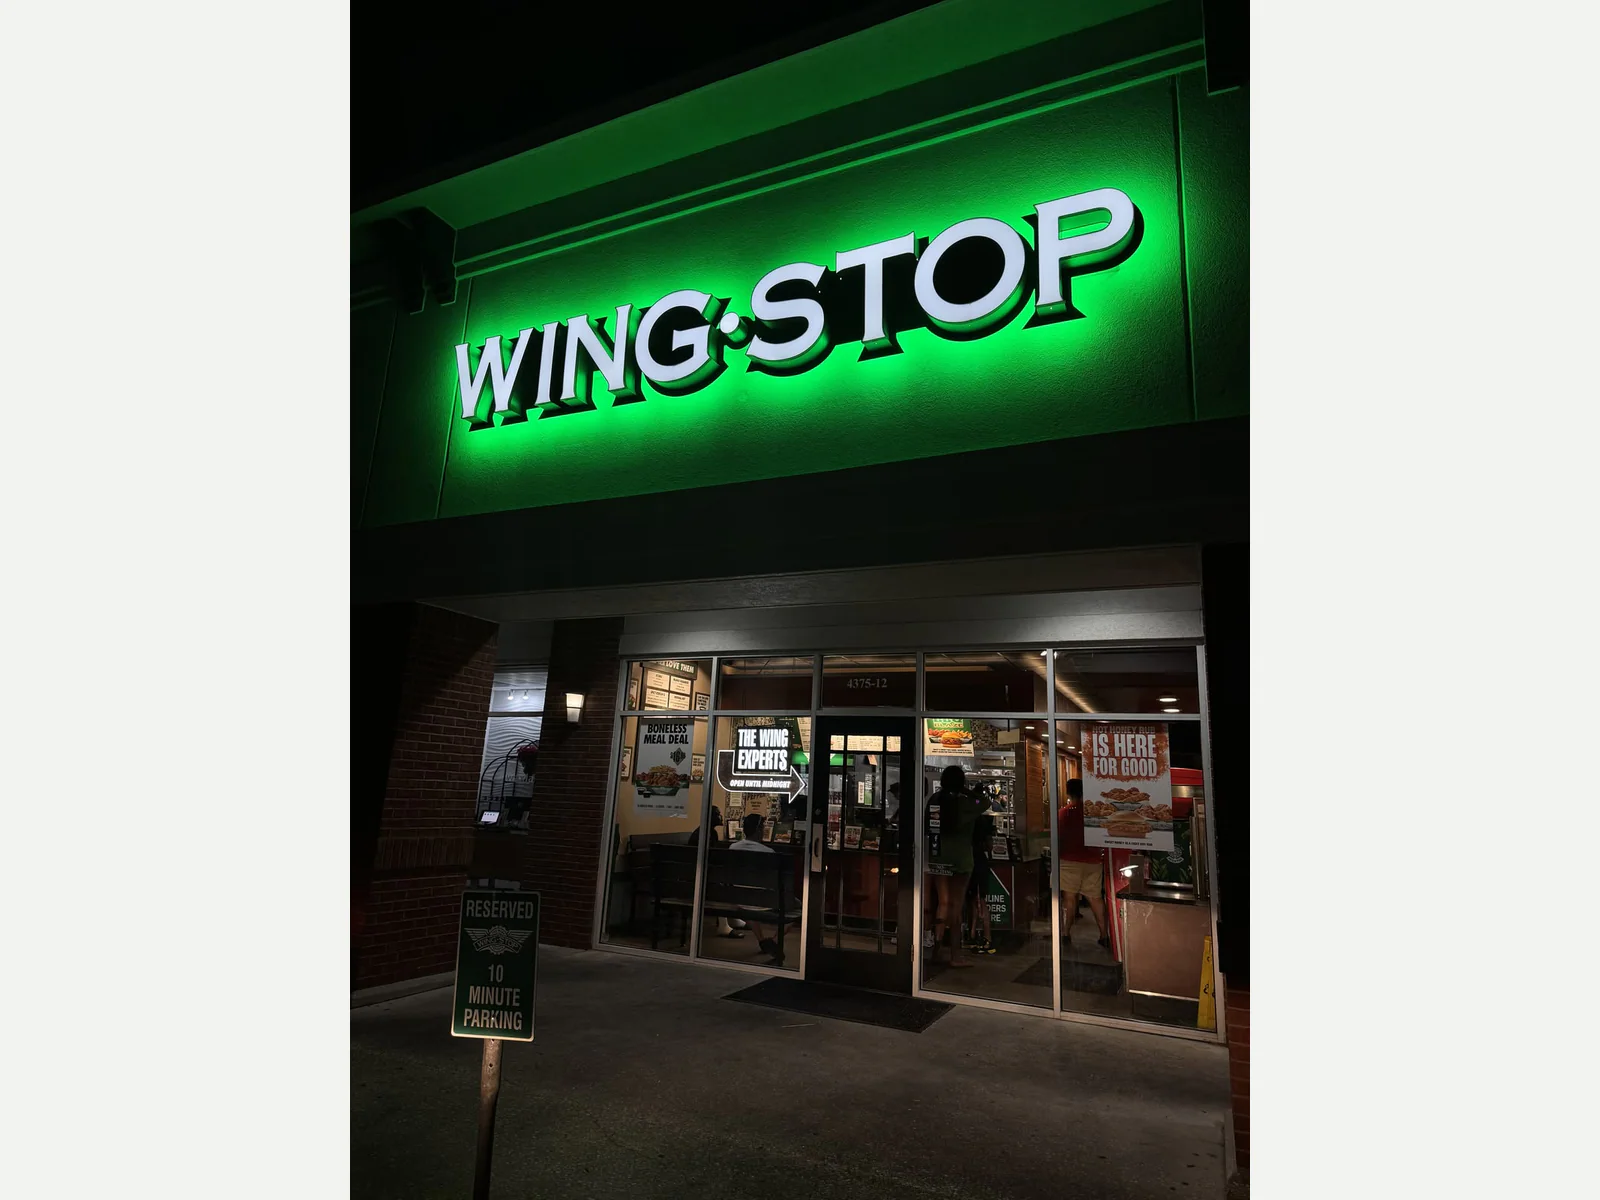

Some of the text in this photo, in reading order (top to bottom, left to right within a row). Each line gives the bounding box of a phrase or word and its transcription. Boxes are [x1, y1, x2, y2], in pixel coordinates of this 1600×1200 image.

[680, 663, 694, 674] THEM
[846, 678, 888, 689] 4375-12
[647, 723, 688, 734] BONELESS
[1092, 725, 1108, 734] HOT
[1110, 725, 1138, 734] HONEY
[643, 734, 689, 745] MEAL DEAL
[737, 728, 757, 747] THE
[759, 728, 789, 748] WING
[1092, 733, 1157, 758] IS HERE
[1093, 757, 1158, 777] FOR GOOD
[729, 779, 791, 788] OPEN UNTIL MIDNIGHT
[985, 894, 1004, 903] LINE
[466, 899, 534, 919] RESERVED
[986, 904, 1006, 913] DERS
[990, 914, 1001, 922] RE
[488, 964, 504, 983] 10
[468, 985, 521, 1007] MINUTE
[463, 1008, 523, 1031] PARKING
